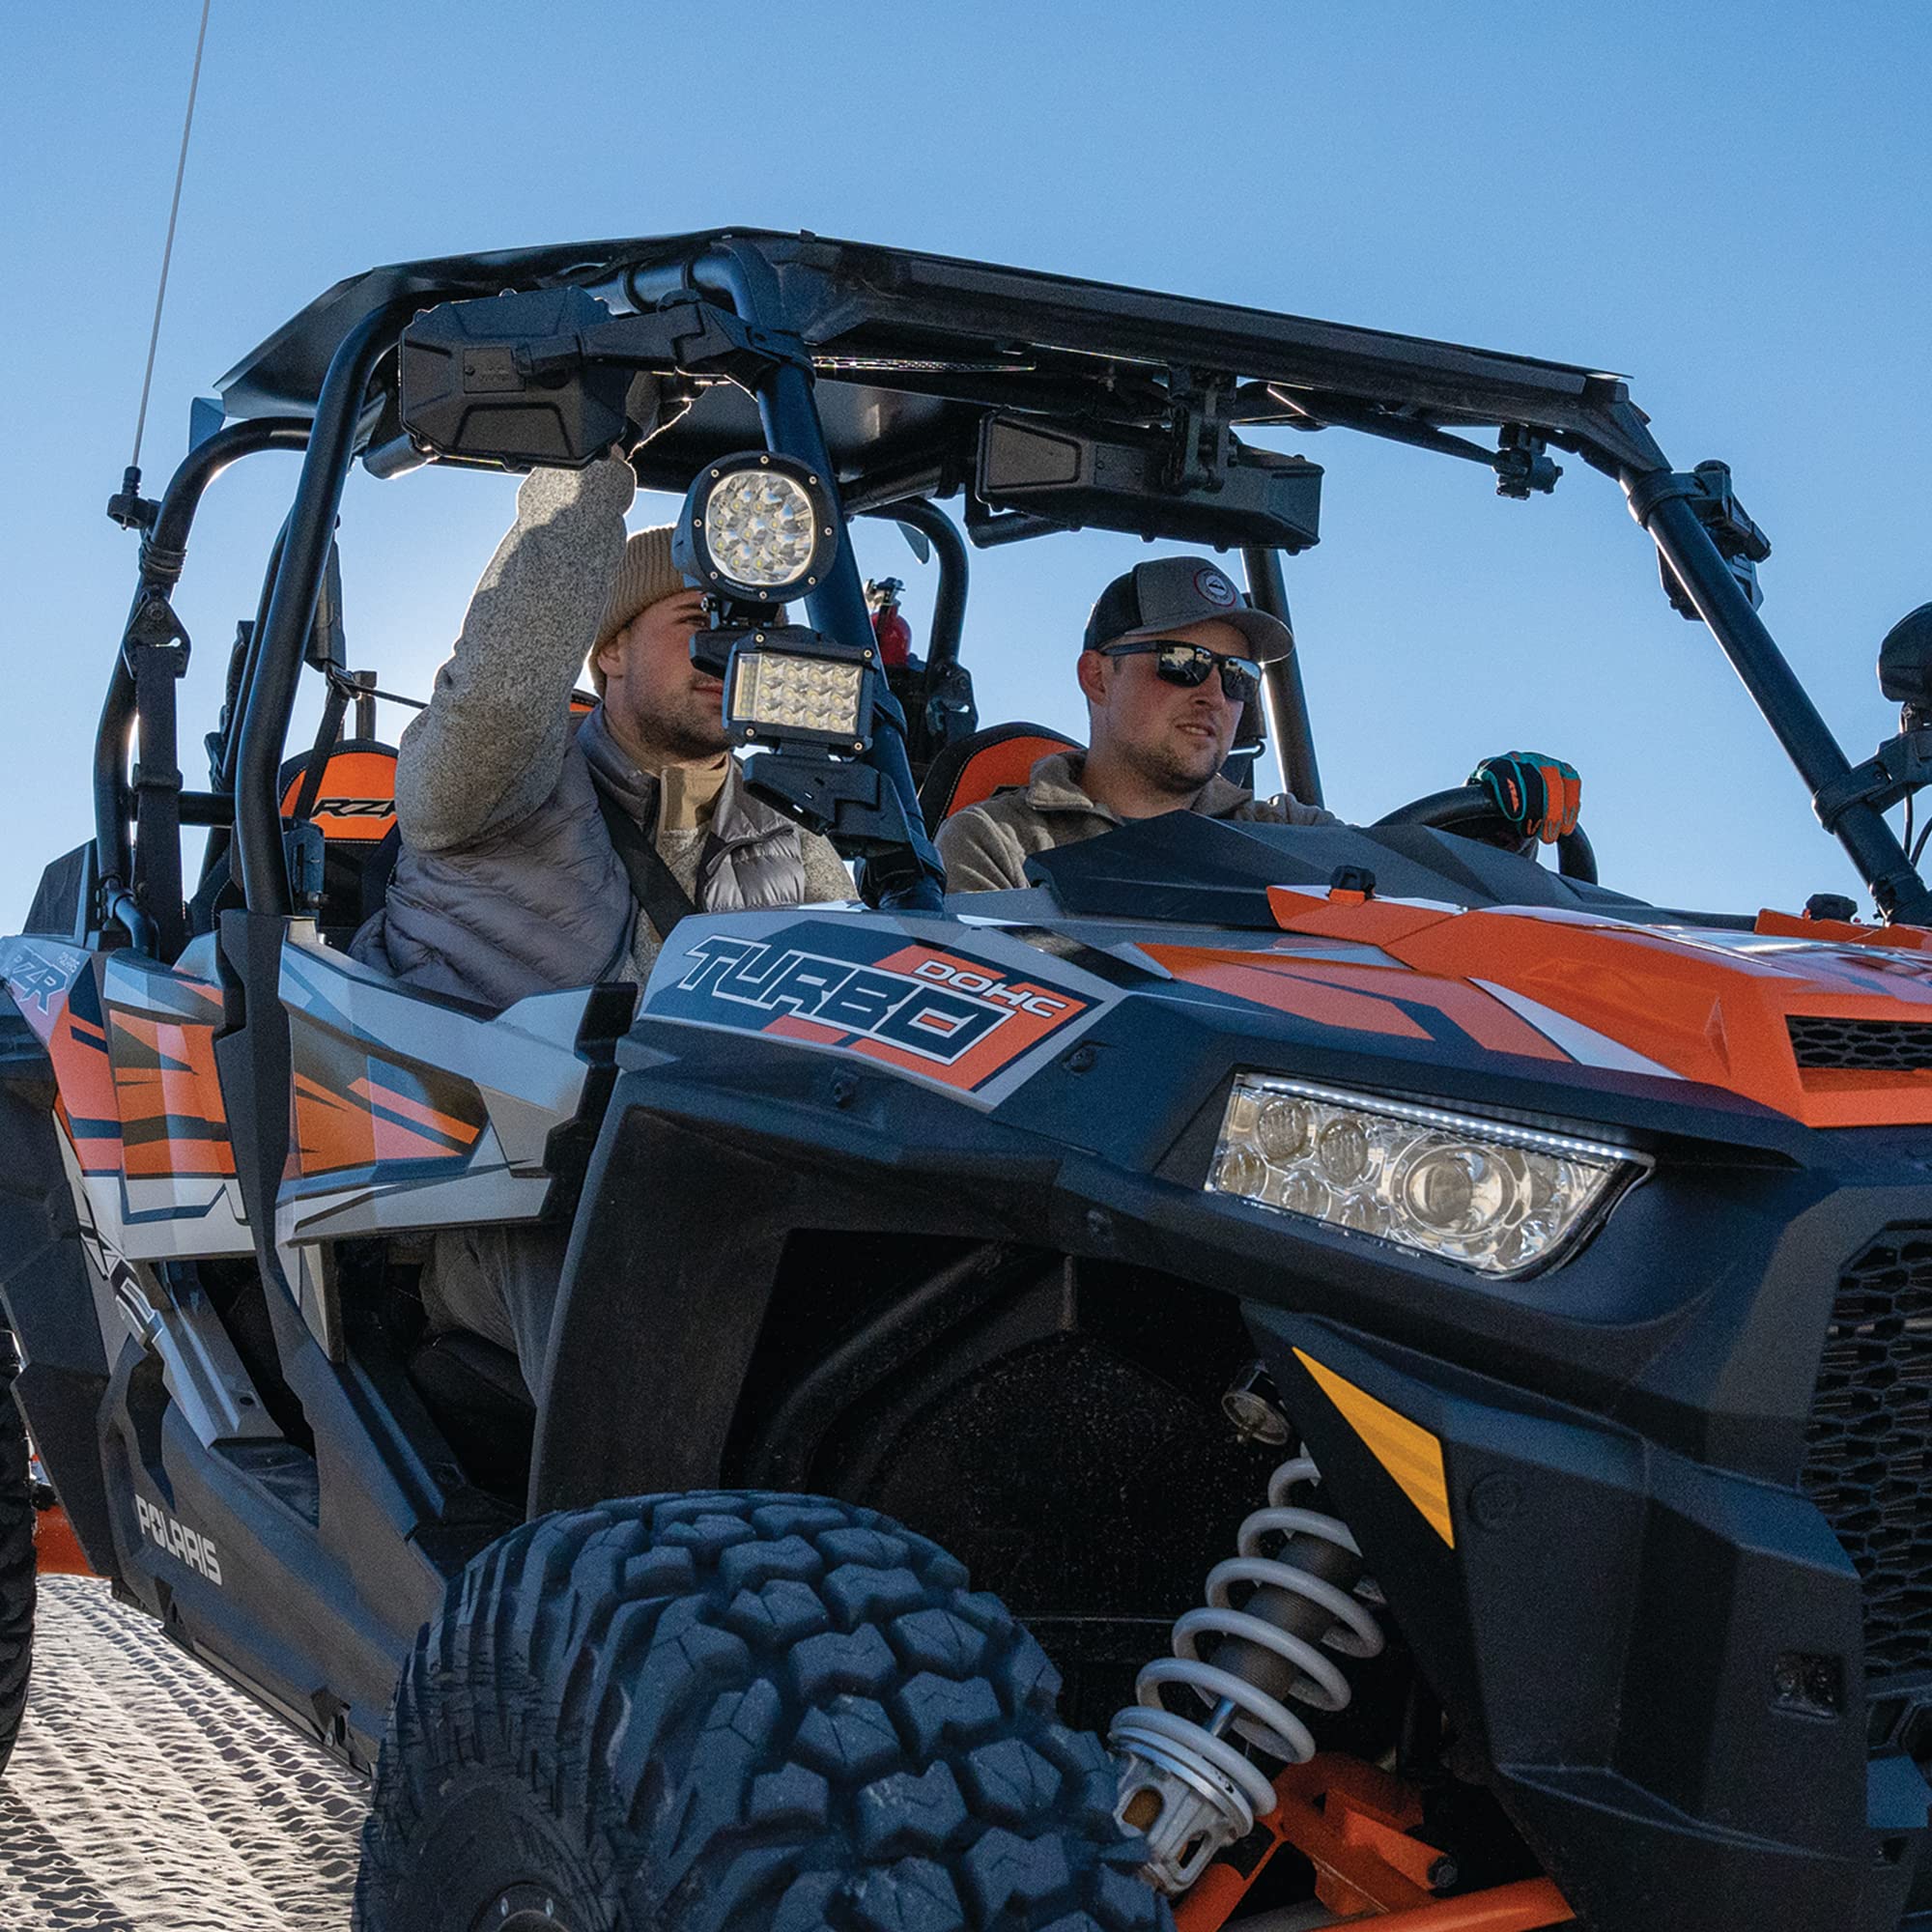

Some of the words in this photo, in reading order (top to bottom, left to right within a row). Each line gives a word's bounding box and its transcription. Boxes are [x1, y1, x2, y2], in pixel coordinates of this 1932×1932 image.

[677, 934, 1017, 1066] TURBO
[914, 959, 1066, 1018] DOHC
[135, 1493, 221, 1586] POLARIS
